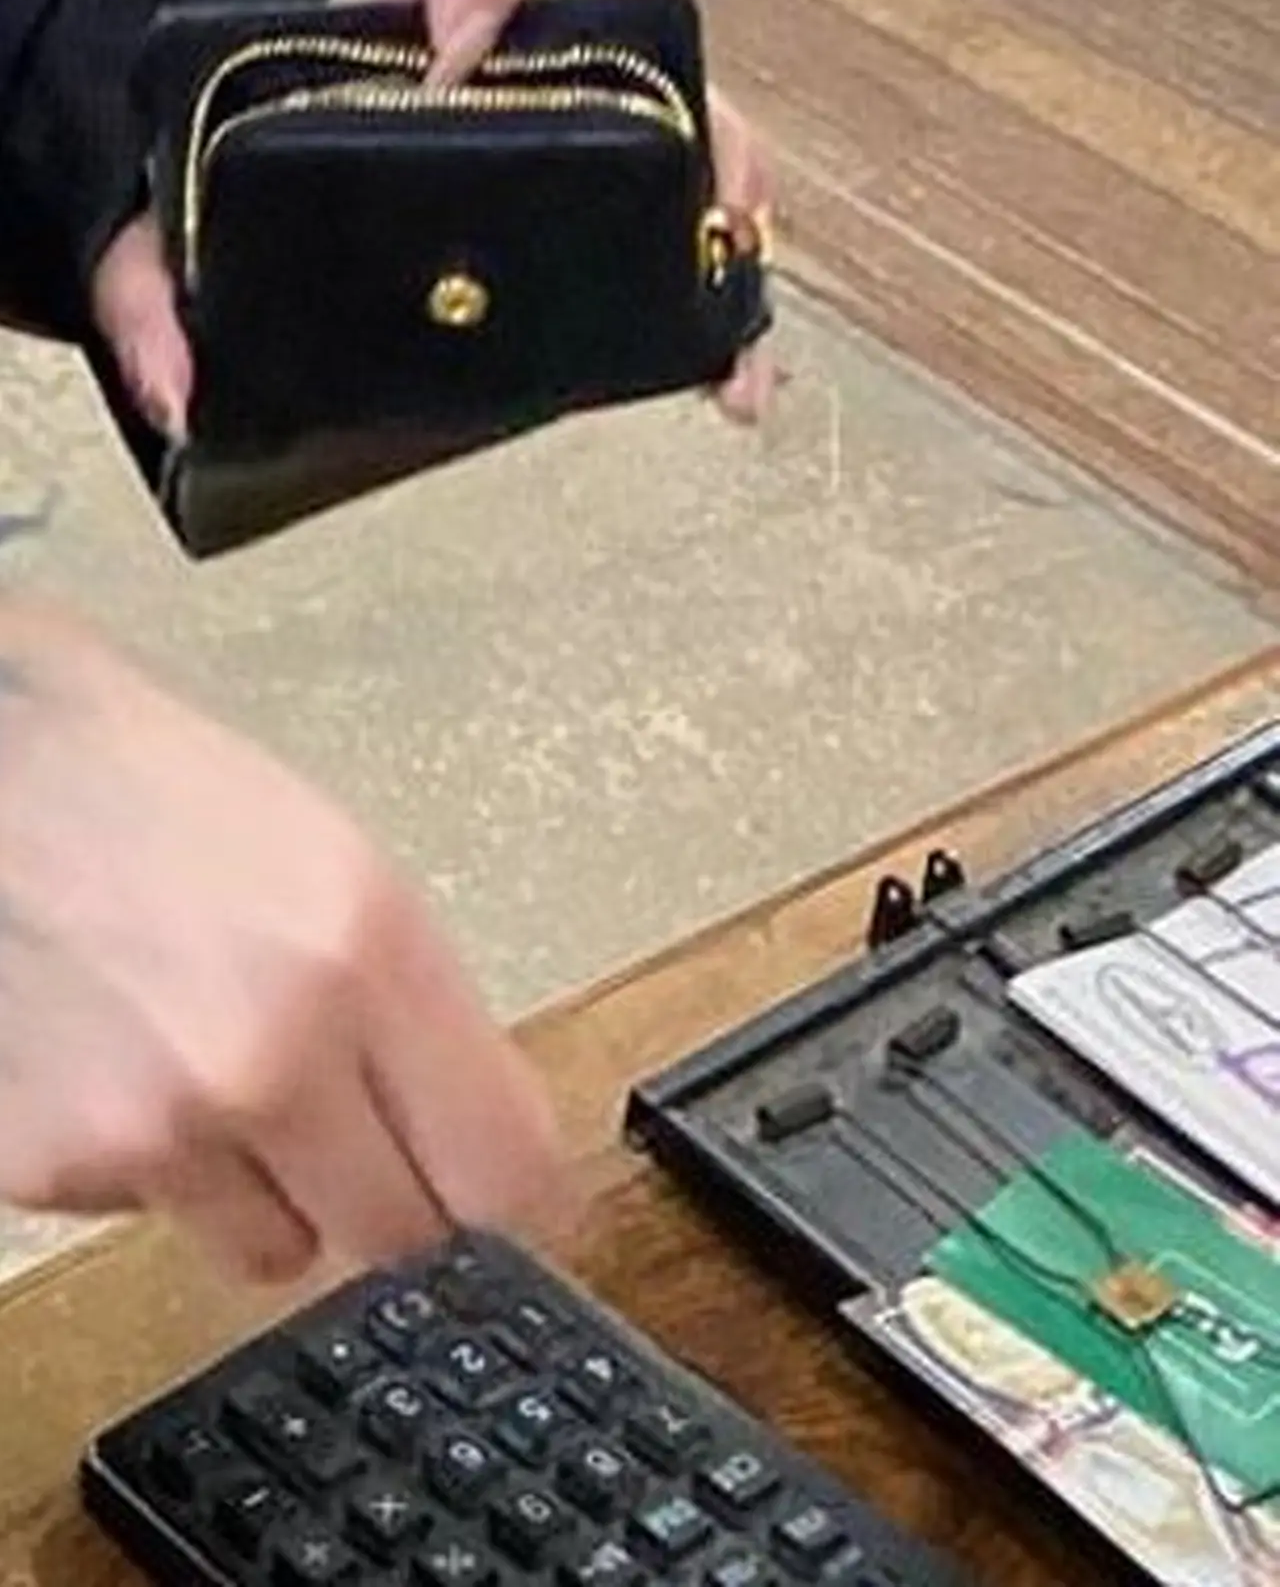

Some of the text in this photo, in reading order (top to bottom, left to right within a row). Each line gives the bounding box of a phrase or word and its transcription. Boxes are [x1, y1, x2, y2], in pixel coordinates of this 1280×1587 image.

[450, 1343, 486, 1373] 2
[384, 1387, 422, 1417] 3
[449, 1355, 614, 1470] 4 5 6
